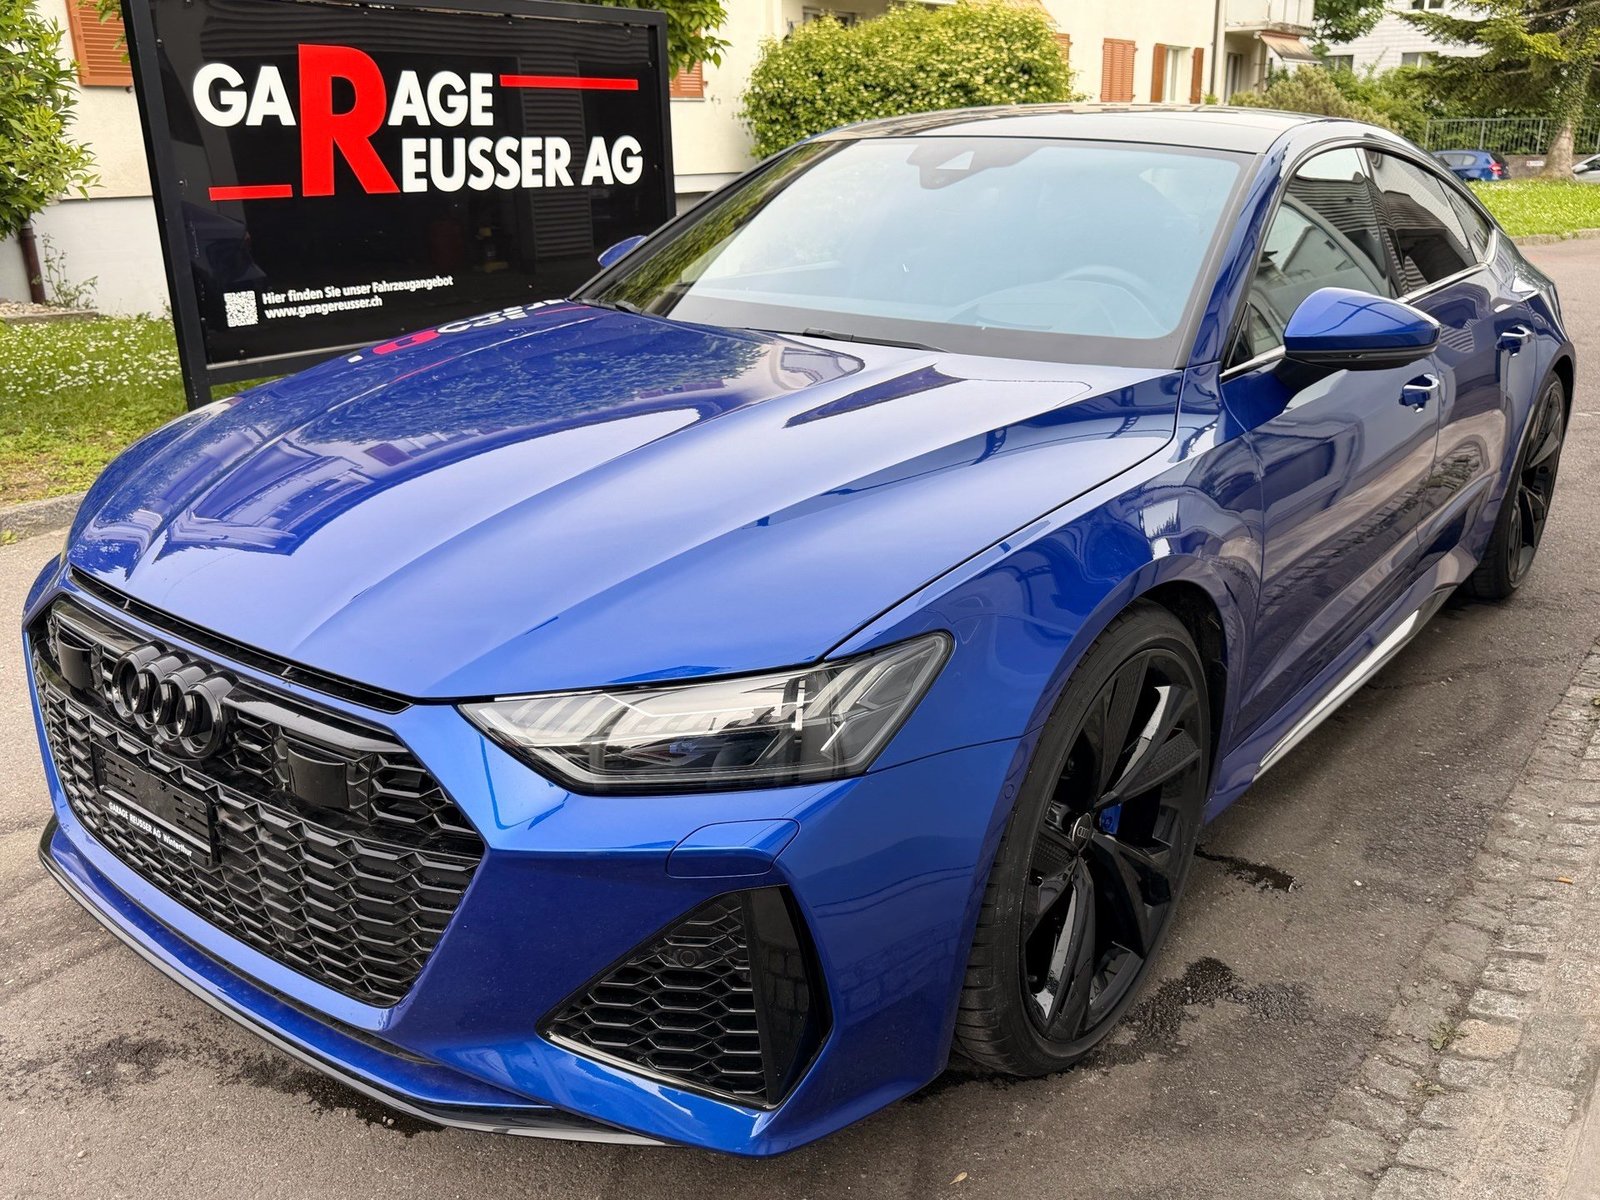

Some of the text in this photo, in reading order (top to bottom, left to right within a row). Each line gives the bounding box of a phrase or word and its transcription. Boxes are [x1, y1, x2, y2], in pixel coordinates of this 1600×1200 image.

[192, 43, 494, 197] GARAGE
[581, 134, 643, 187] AG
[262, 275, 454, 305] Hier finden Sie unser Fahrzeugangebot
[265, 296, 383, 318] www.garagereusser.ch
[108, 801, 193, 857] GARAGE REUSSER AG Winterthur
